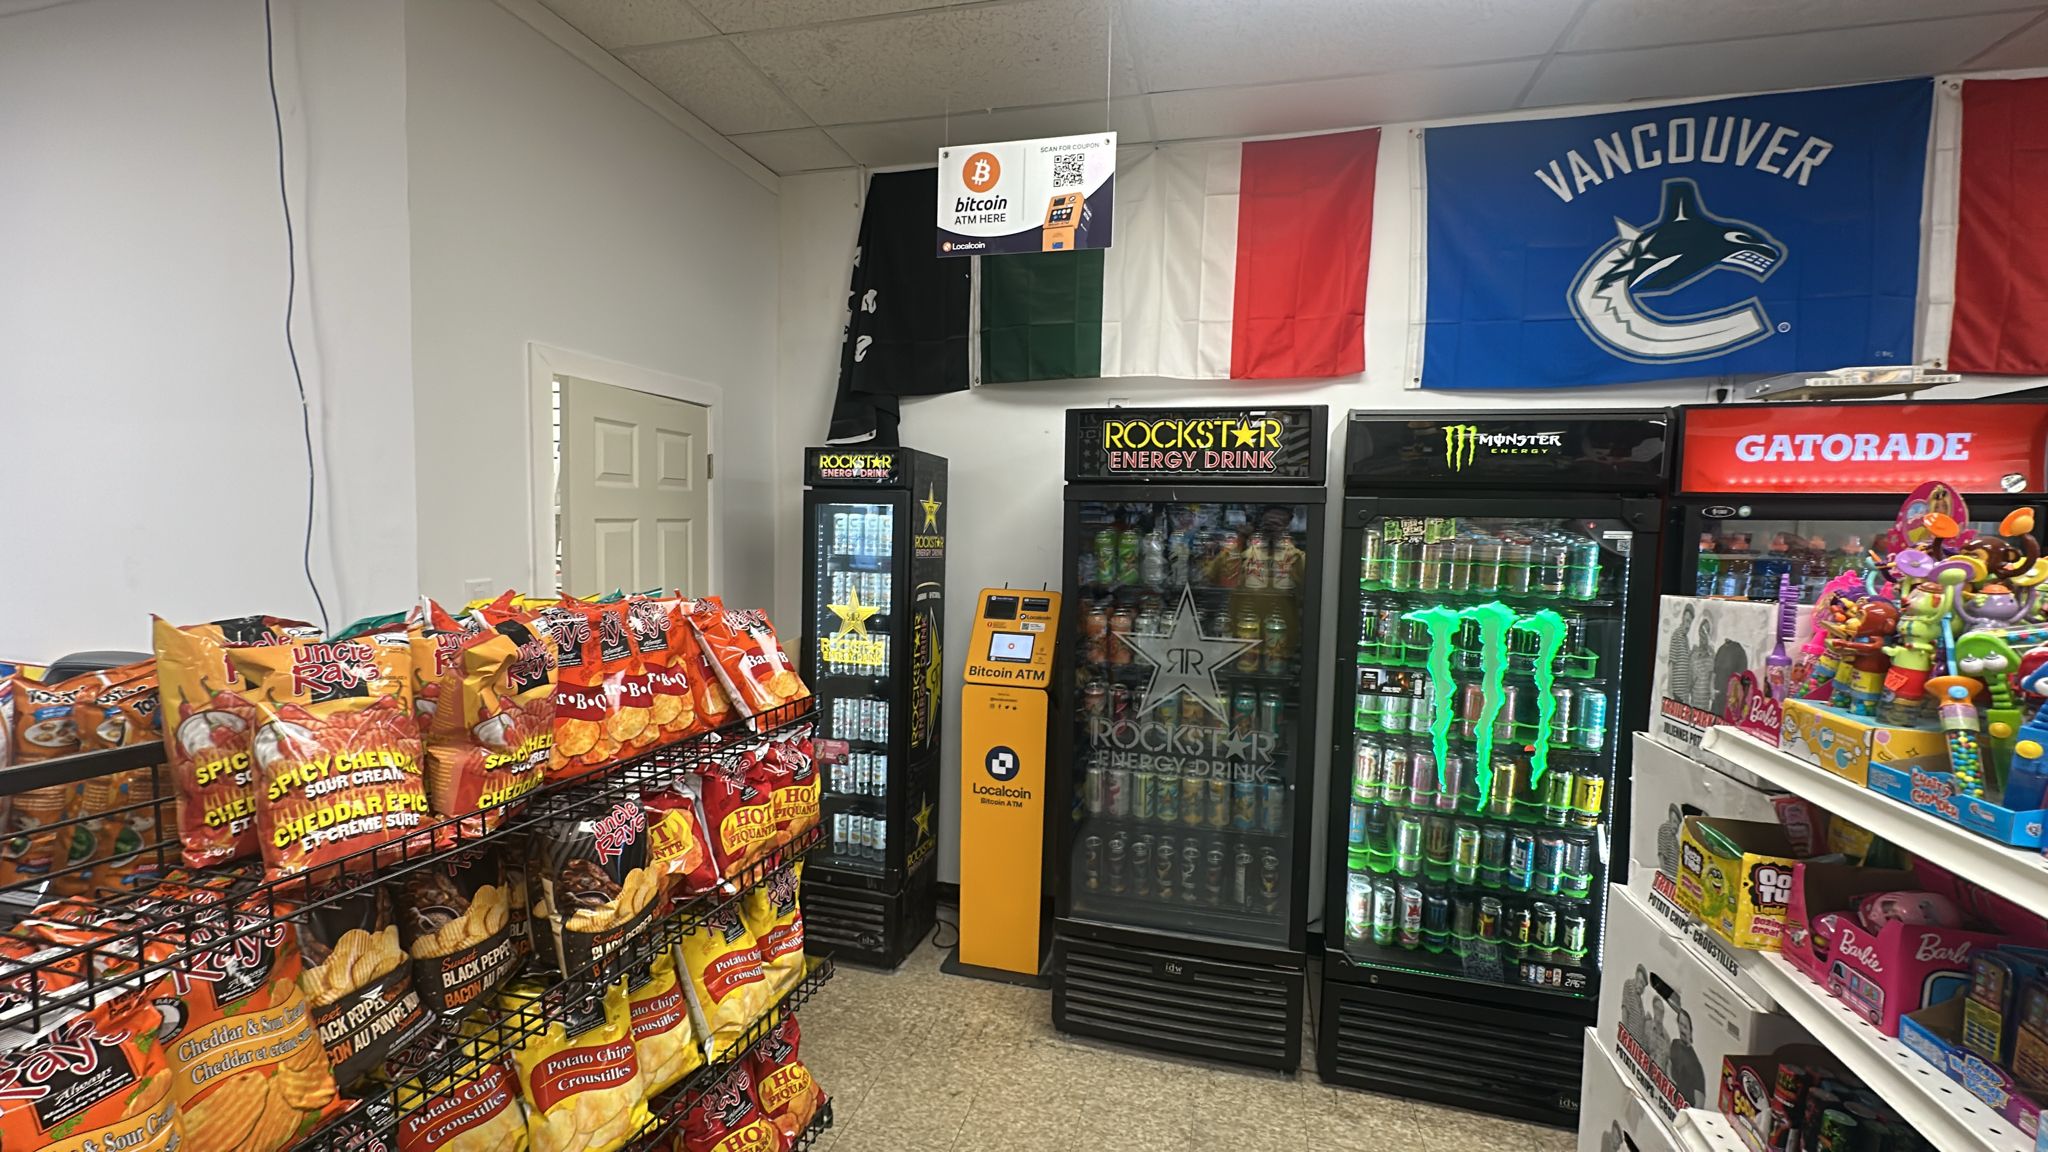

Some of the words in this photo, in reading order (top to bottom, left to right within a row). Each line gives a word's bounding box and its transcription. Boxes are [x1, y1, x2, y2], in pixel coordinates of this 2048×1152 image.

[1058, 144, 1071, 152] FOR
[1534, 116, 1834, 204] VANCOUVER
[955, 195, 1007, 212] bitcoin
[954, 214, 976, 225] ATM
[979, 213, 1006, 224] HERE
[952, 242, 986, 250] Localcoin
[1478, 433, 1562, 447] MONSTER
[1735, 432, 1972, 462] GATORADE
[821, 468, 858, 478] ENERGY
[860, 469, 889, 478] DRINK
[1110, 450, 1197, 468] ENERGY
[1204, 450, 1274, 469] DRINK
[294, 644, 374, 664] uncle
[969, 665, 1012, 680] Bitcoin
[1016, 670, 1045, 681] ATM
[1750, 696, 1779, 728] Barbie
[268, 757, 332, 801] SPICY
[1099, 750, 1188, 777] ENERGY
[1194, 760, 1266, 783] DRINK
[305, 774, 349, 798] SOUR
[352, 770, 406, 785] CREAM
[784, 786, 818, 803] HOT
[972, 782, 1031, 799] Localcoin
[736, 806, 772, 828] HOT
[980, 797, 1004, 807] Bitcoin
[1006, 799, 1022, 808] ATM
[274, 796, 383, 848] CHEDDAR
[591, 802, 638, 839] uncle
[1648, 892, 1670, 918] POTATO
[1693, 930, 1738, 976] CROUSTILLES
[442, 948, 478, 972] Sweet
[716, 954, 747, 973] Potato
[1840, 929, 1883, 972] Barbie
[442, 958, 480, 988] BLACK
[444, 980, 481, 1008] BACON
[482, 970, 494, 991] AU
[650, 992, 680, 1014] Chips
[346, 992, 388, 1028] PEPPER
[178, 1024, 243, 1062] Cheddar
[246, 1020, 259, 1036] &
[260, 1016, 283, 1032] Sour
[354, 1028, 370, 1053] AU
[370, 1002, 408, 1040] POIVRE
[191, 1050, 252, 1085] Cheddar
[256, 1046, 268, 1058] et
[546, 1051, 594, 1076] Potato
[596, 1043, 632, 1063] Chips
[1616, 1043, 1636, 1075] POTATO
[1618, 1023, 1650, 1074] TRAILER
[1650, 1062, 1676, 1105] PARK
[558, 1063, 632, 1092] Croustilles
[409, 1092, 462, 1132] Potato
[464, 1070, 502, 1101] Chips
[426, 1091, 507, 1144] Croustilles
[104, 1128, 144, 1152] Sour
